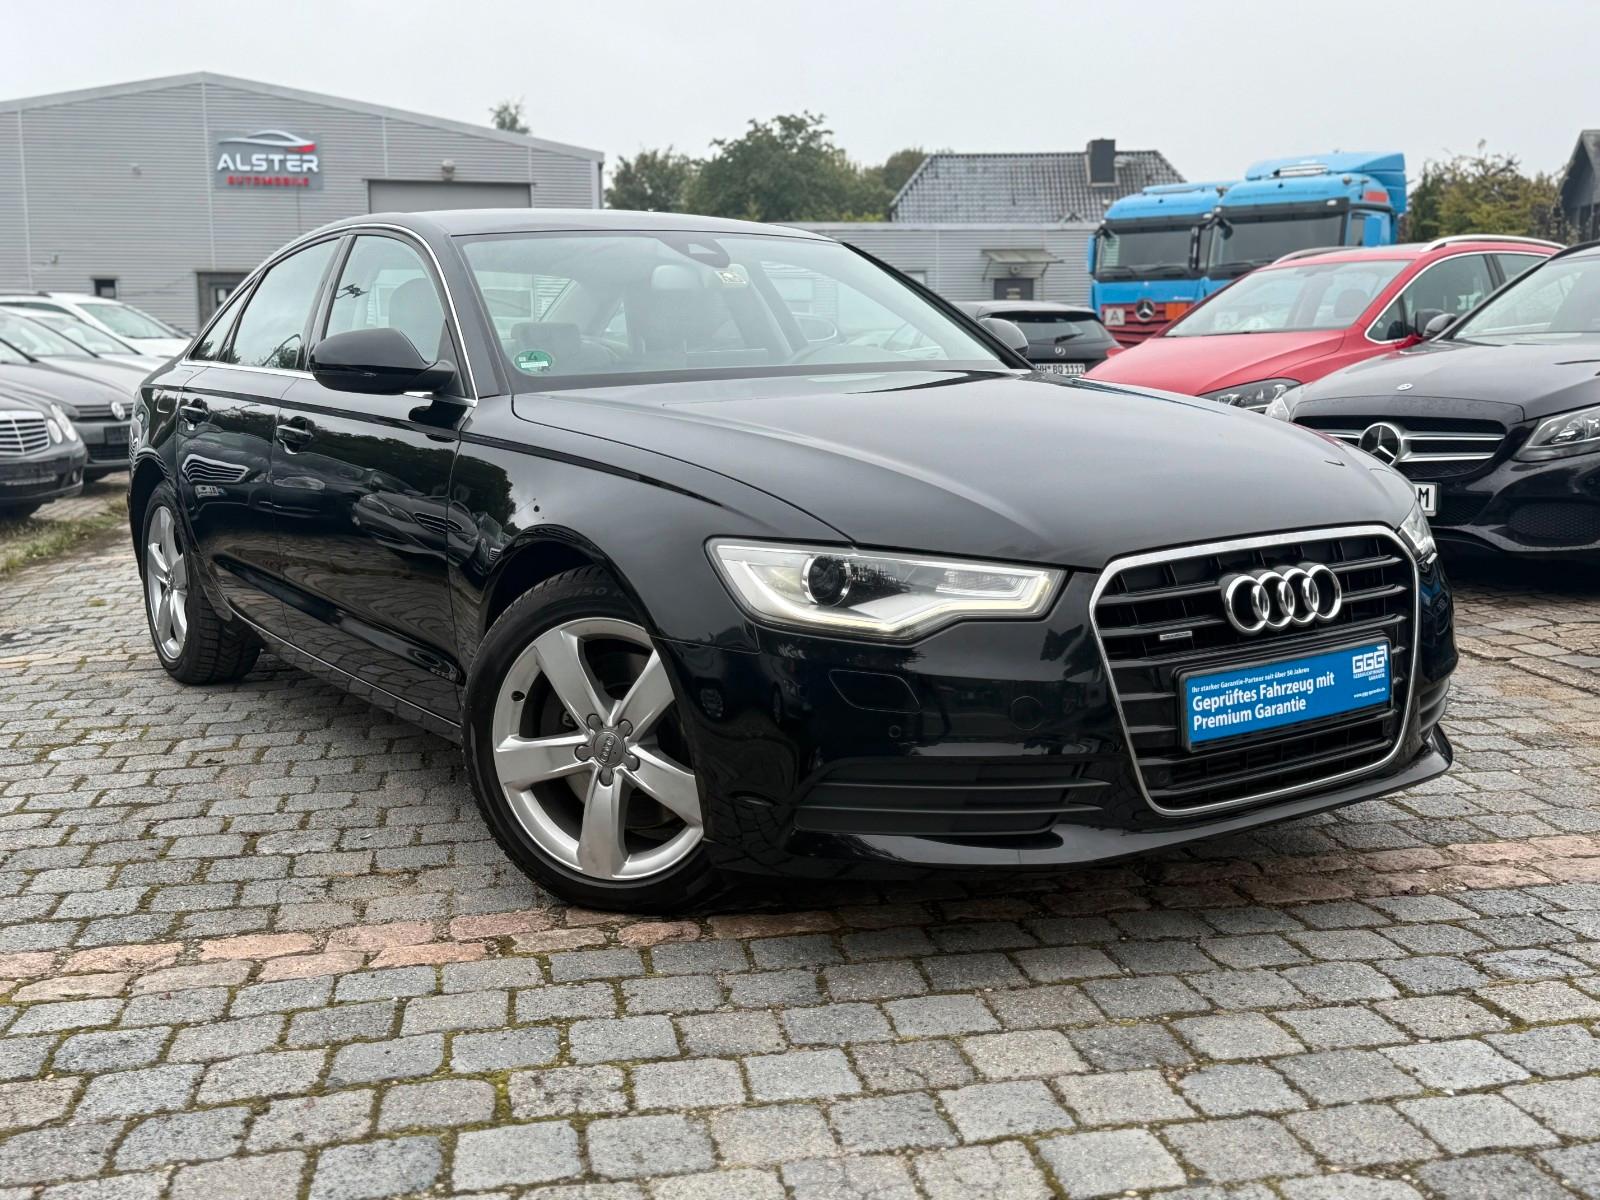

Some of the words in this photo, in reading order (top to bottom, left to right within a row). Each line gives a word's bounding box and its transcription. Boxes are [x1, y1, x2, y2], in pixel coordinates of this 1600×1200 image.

[217, 153, 319, 173] ALSTER
[1418, 487, 1430, 508] M
[1352, 650, 1386, 674] GGG
[1192, 687, 1257, 712] Geprüftes
[1260, 678, 1314, 700] Fahrzeug
[1316, 671, 1335, 689] mit
[1200, 682, 1220, 692] starker
[1220, 675, 1264, 688] Garantie-Partner
[1193, 709, 1252, 731] Premium
[1254, 697, 1307, 719] Garantie
